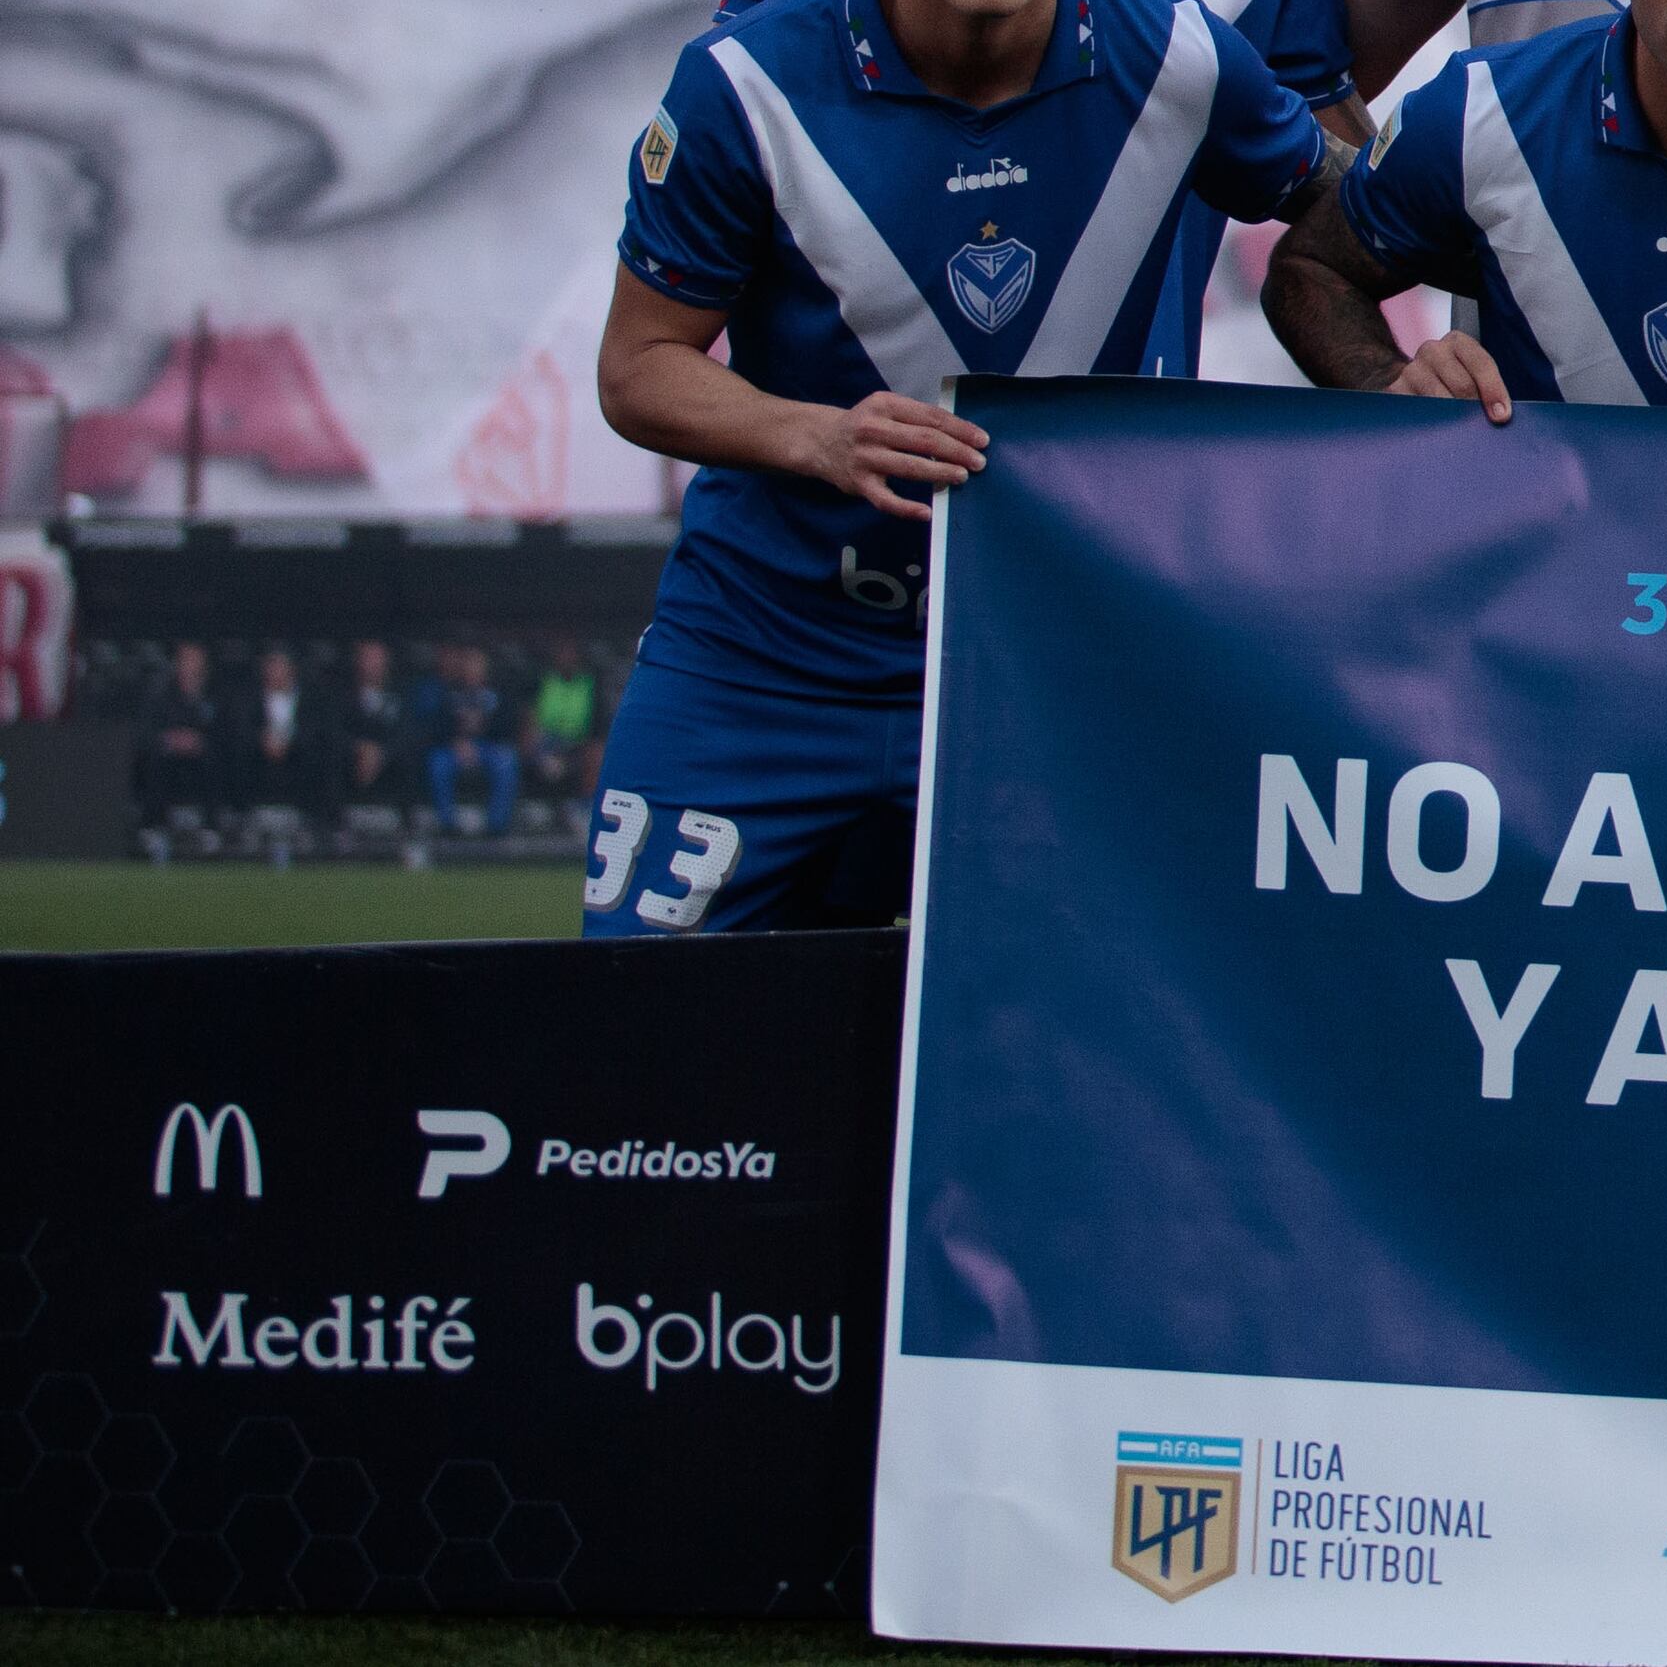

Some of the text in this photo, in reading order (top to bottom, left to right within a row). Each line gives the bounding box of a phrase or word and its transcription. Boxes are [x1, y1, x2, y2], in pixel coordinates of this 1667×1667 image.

[946, 157, 1028, 193] diadora
[583, 788, 743, 928] 33
[1255, 754, 1501, 902] NO
[1542, 772, 1667, 912] A
[1445, 959, 1560, 1099] Y
[536, 1139, 776, 1181] PedidosYa
[153, 1291, 475, 1372] Medifé
[576, 1282, 841, 1394] bplay
[1160, 1439, 1201, 1458] AFA
[1274, 1440, 1345, 1482] LIGA
[1271, 1489, 1492, 1540] PROFESIONAL
[1269, 1537, 1442, 1586] DE FÚTBOL
